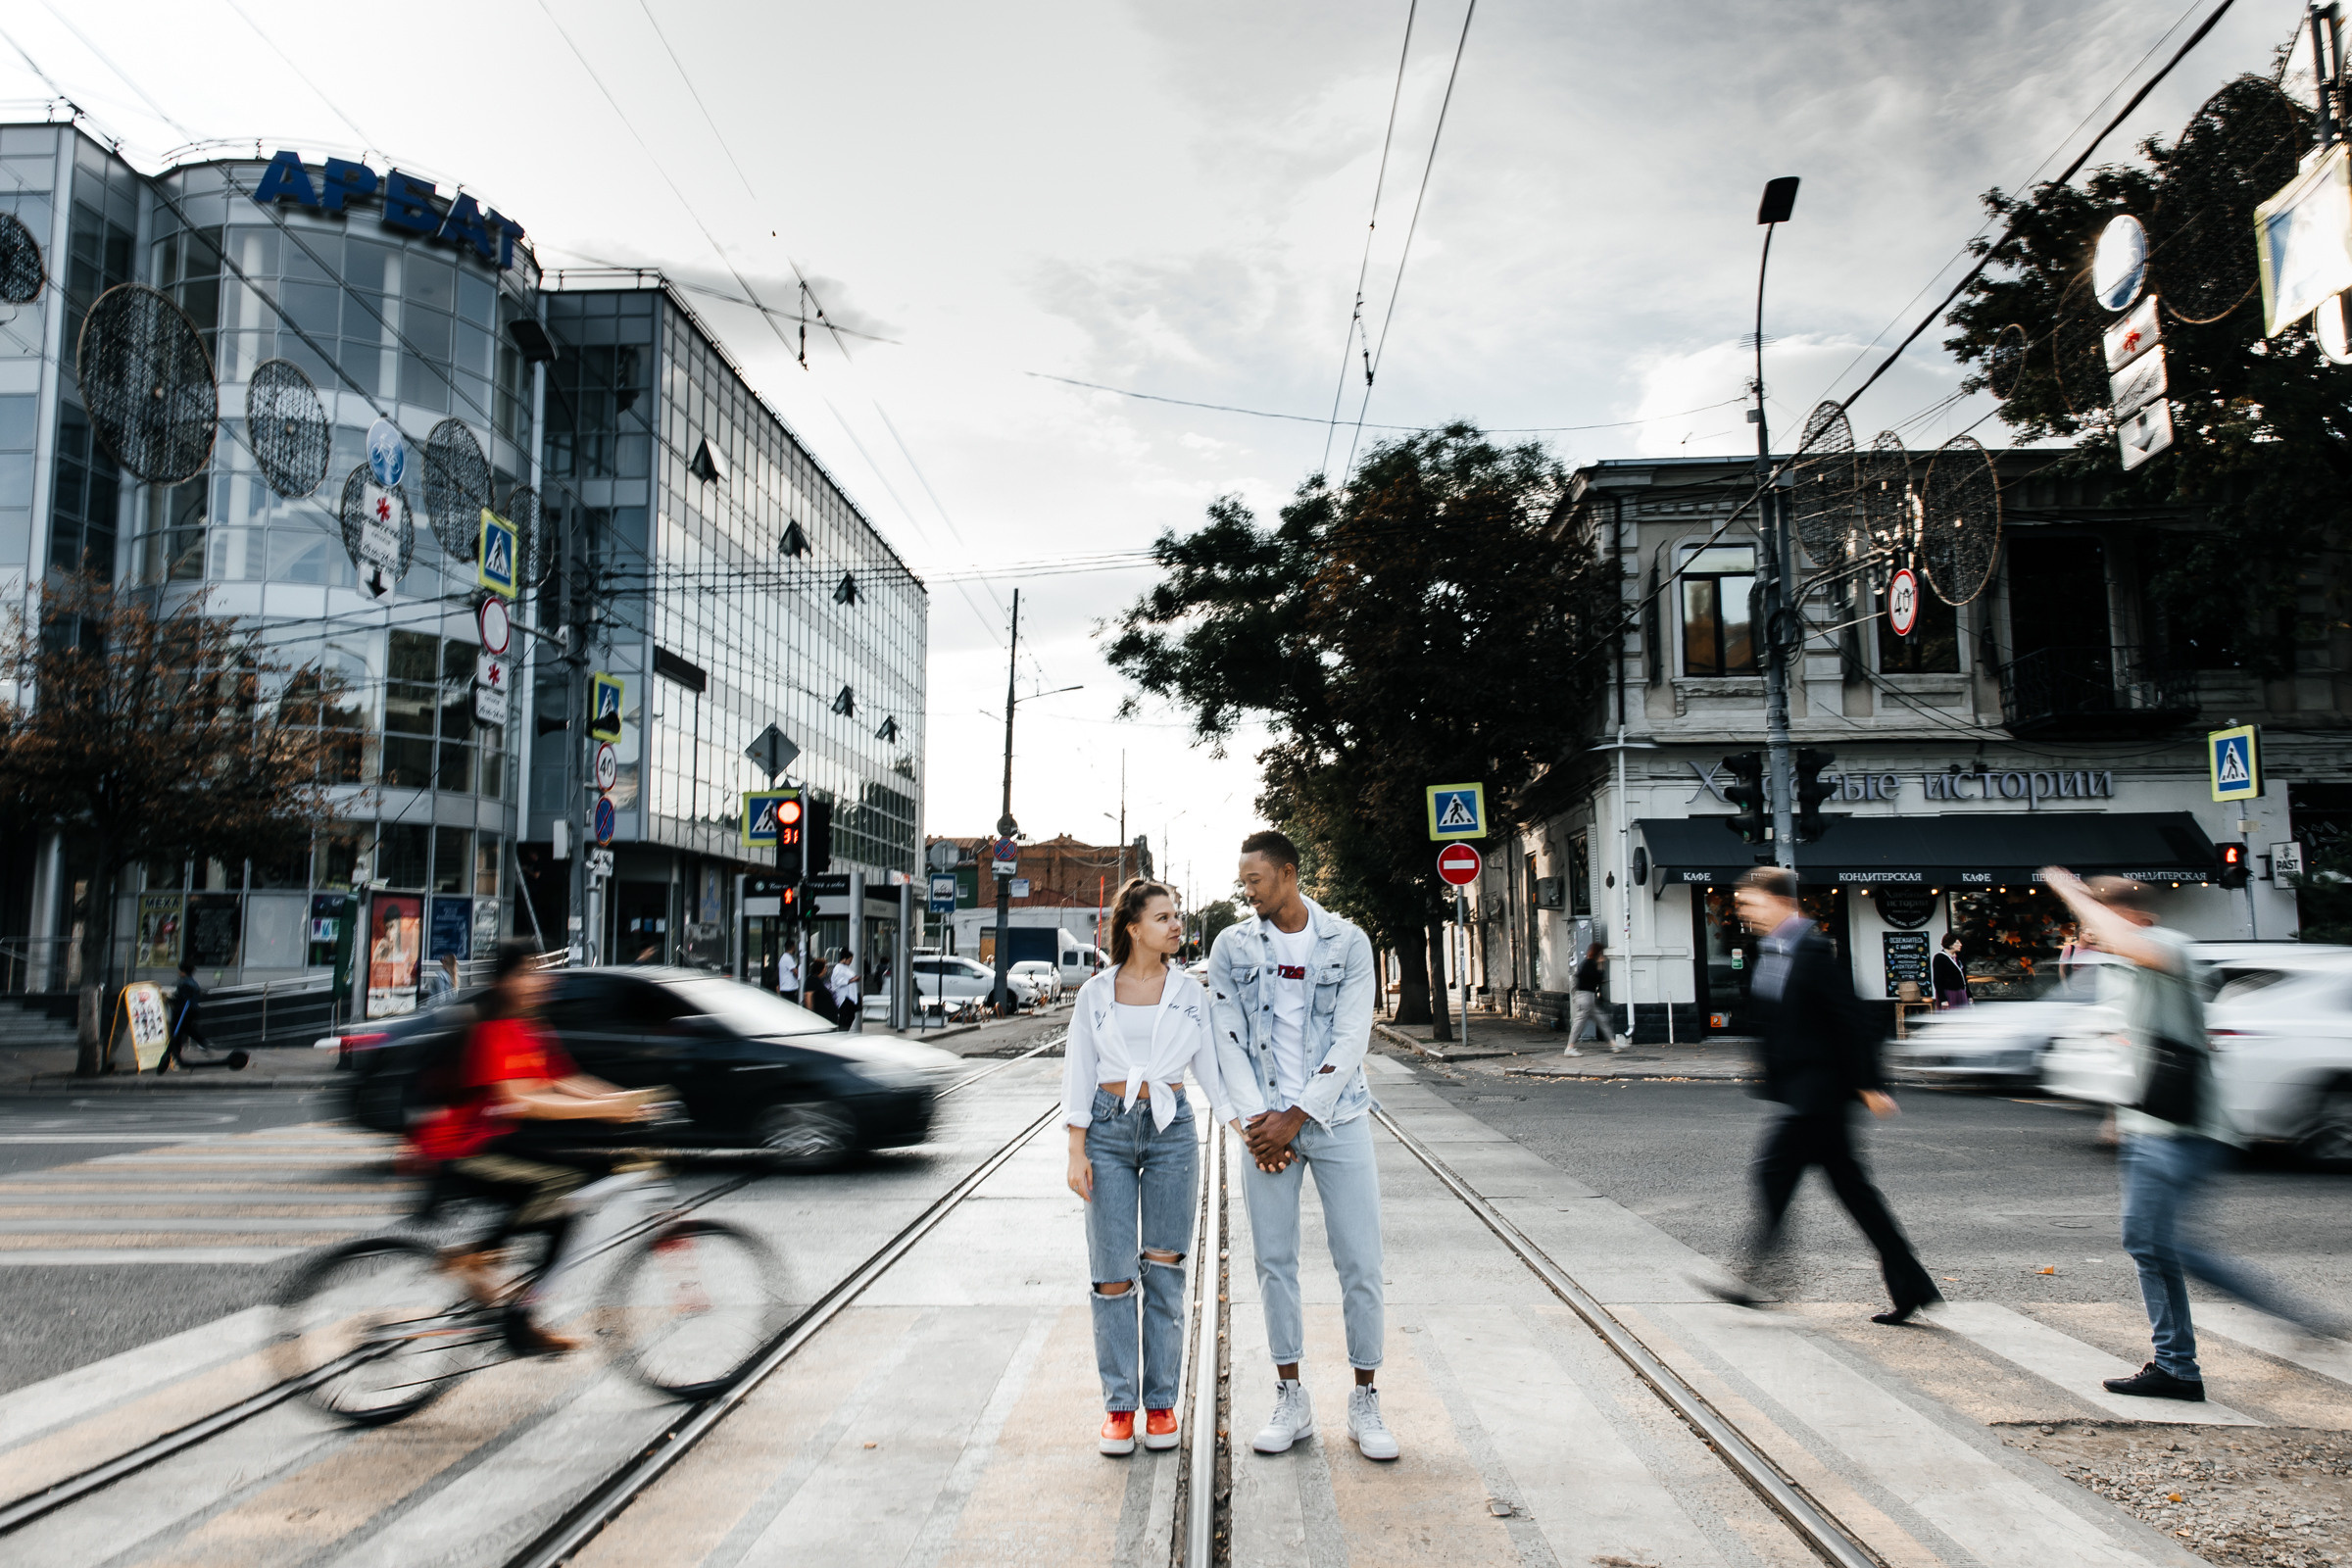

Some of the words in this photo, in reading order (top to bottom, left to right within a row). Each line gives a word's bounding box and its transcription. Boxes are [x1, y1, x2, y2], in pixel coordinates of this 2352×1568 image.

[254, 150, 525, 270] АРБАТ
[1894, 588, 1909, 615] 40
[600, 757, 612, 777] 40
[1922, 770, 2114, 810] истории
[2276, 859, 2299, 870] PAST
[1683, 872, 1712, 882] КАФЕ
[1838, 872, 1922, 882] КОНДИТЕРСКАЯ
[1962, 873, 1991, 882] КАФЕ
[2122, 871, 2208, 882] КОНДИТЕРСКАЯ
[145, 896, 179, 909] МЕХА
